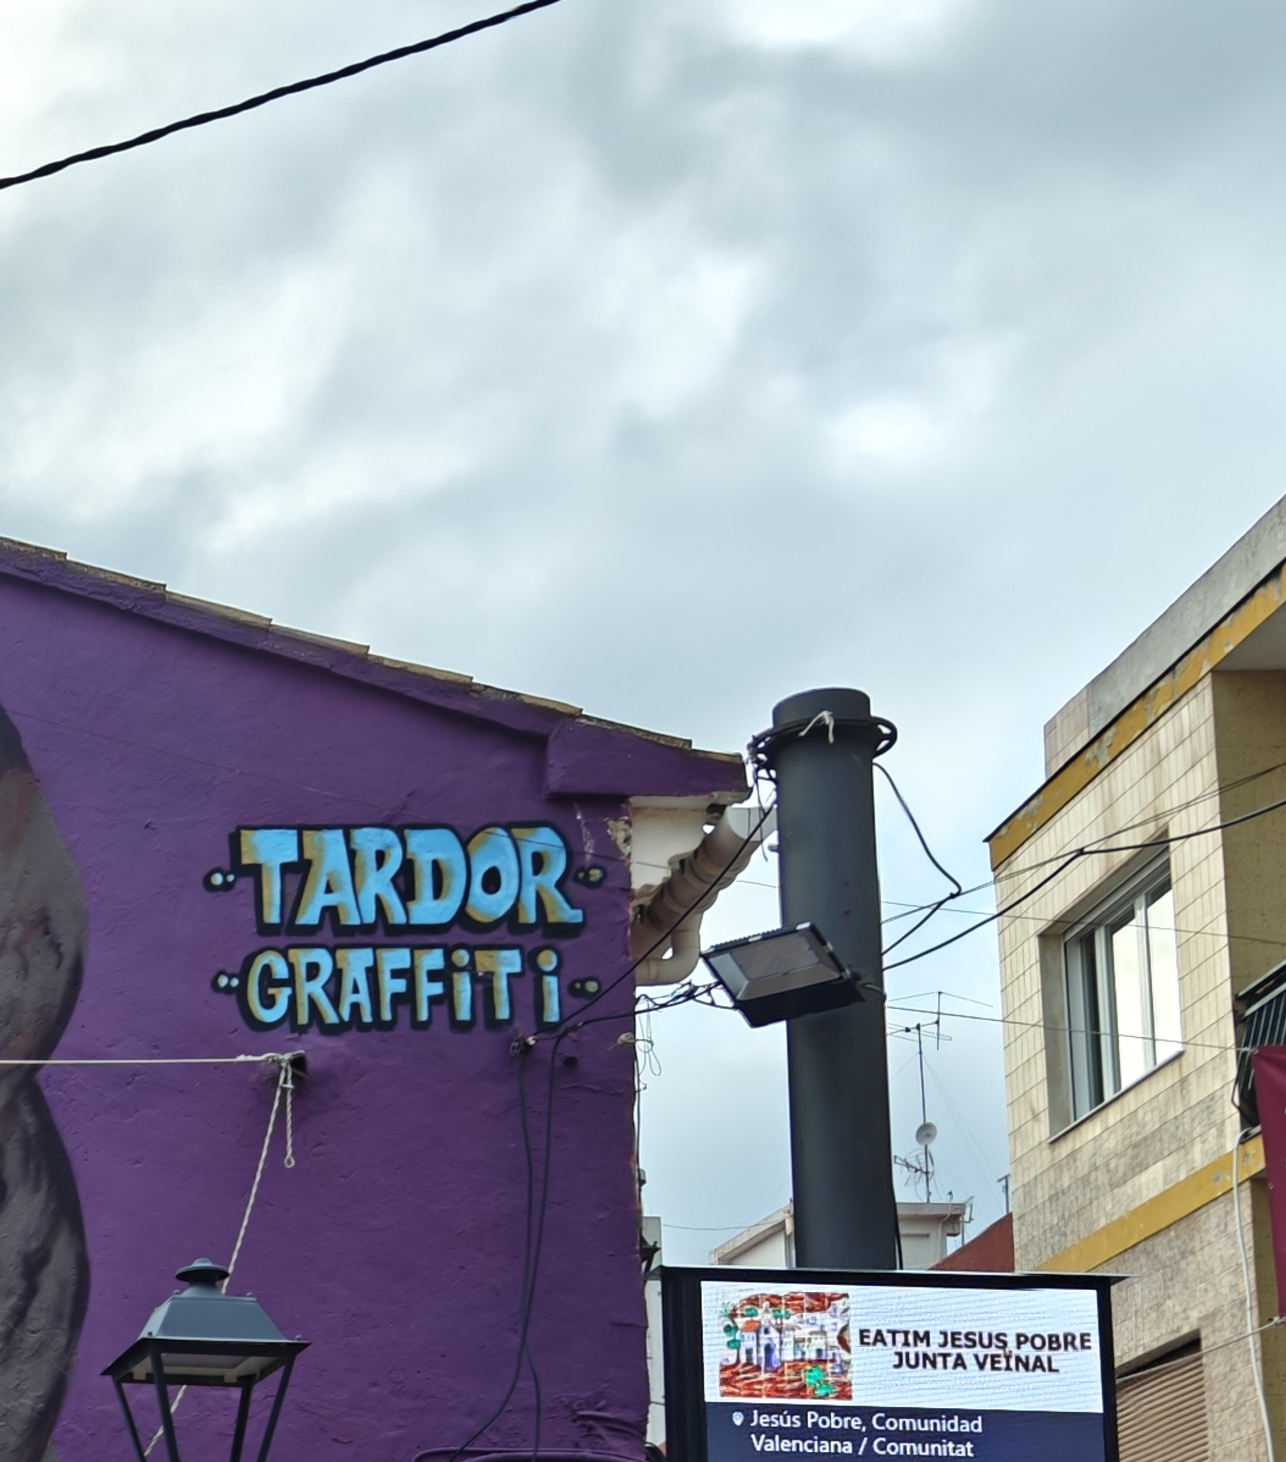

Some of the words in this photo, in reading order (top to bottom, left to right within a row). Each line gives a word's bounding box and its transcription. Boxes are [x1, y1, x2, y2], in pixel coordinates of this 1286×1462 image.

[234, 825, 585, 932] TARDOR
[858, 1328, 930, 1348] EATIM
[937, 1330, 1008, 1350] JESUS
[1015, 1332, 1092, 1351] POBRE
[892, 1351, 967, 1370] JUNTA
[750, 1409, 801, 1428] Jesús
[807, 1411, 866, 1432] Pobre,
[871, 1412, 983, 1433] Comunidad
[750, 1434, 853, 1454] Valenciana
[872, 1437, 975, 1457] Comunitat
